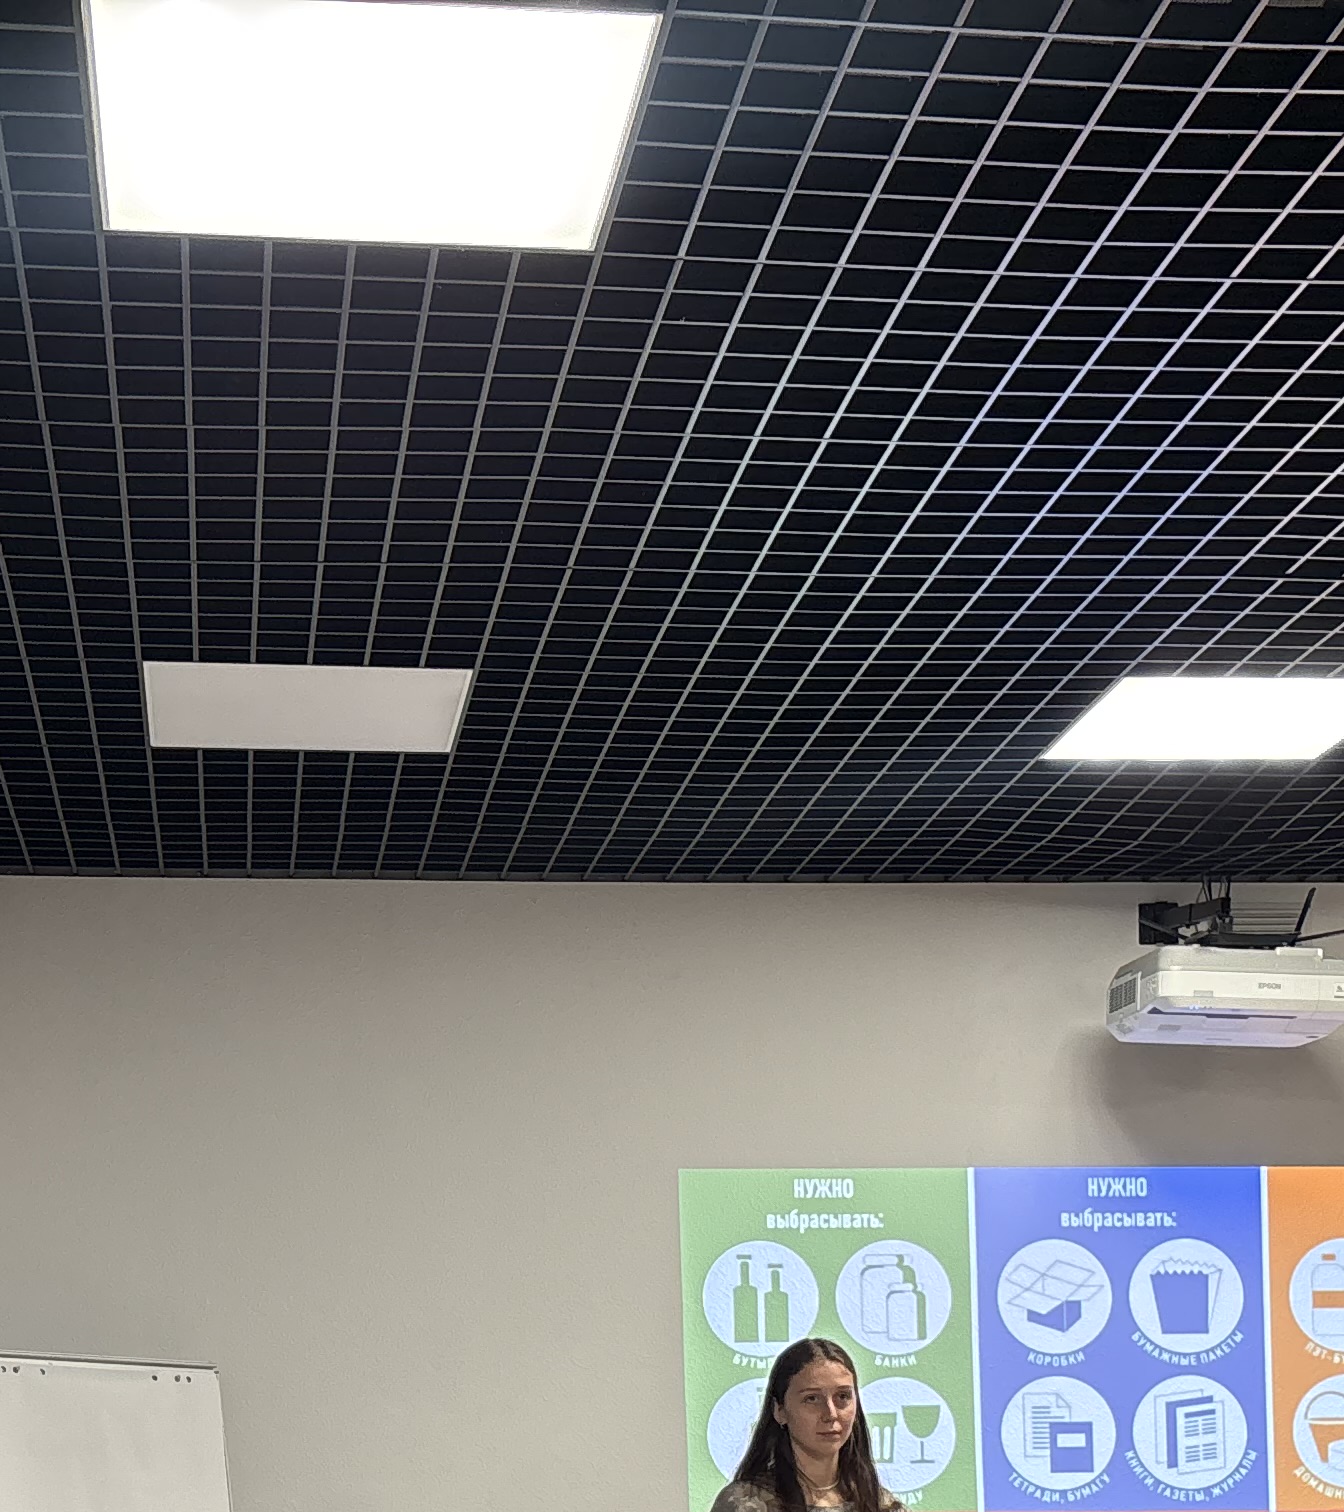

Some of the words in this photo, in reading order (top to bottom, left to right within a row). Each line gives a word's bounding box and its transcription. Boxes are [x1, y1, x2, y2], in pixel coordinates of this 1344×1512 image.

[1258, 982, 1282, 990] EPSON
[793, 1178, 854, 1199] НУЖНО
[1087, 1176, 1148, 1198] НУЖНО
[766, 1208, 884, 1234] выбрасывать:
[1060, 1208, 1177, 1232] выбрасывать:
[1026, 1350, 1086, 1367] КОРОБКИ
[1131, 1330, 1197, 1366] БУМАЖНЫЕ
[1200, 1330, 1245, 1364] ПАКЕТЫ
[874, 1354, 918, 1369] БАНКИ
[1124, 1450, 1155, 1491] КНИГИ,
[1157, 1483, 1210, 1502] ГАЗЕТЫ,
[1212, 1449, 1259, 1498] ЖУРНАЛЫ
[1008, 1471, 1065, 1504] ТЕТРАДИ,
[1066, 1472, 1111, 1502] БУМАГУ
